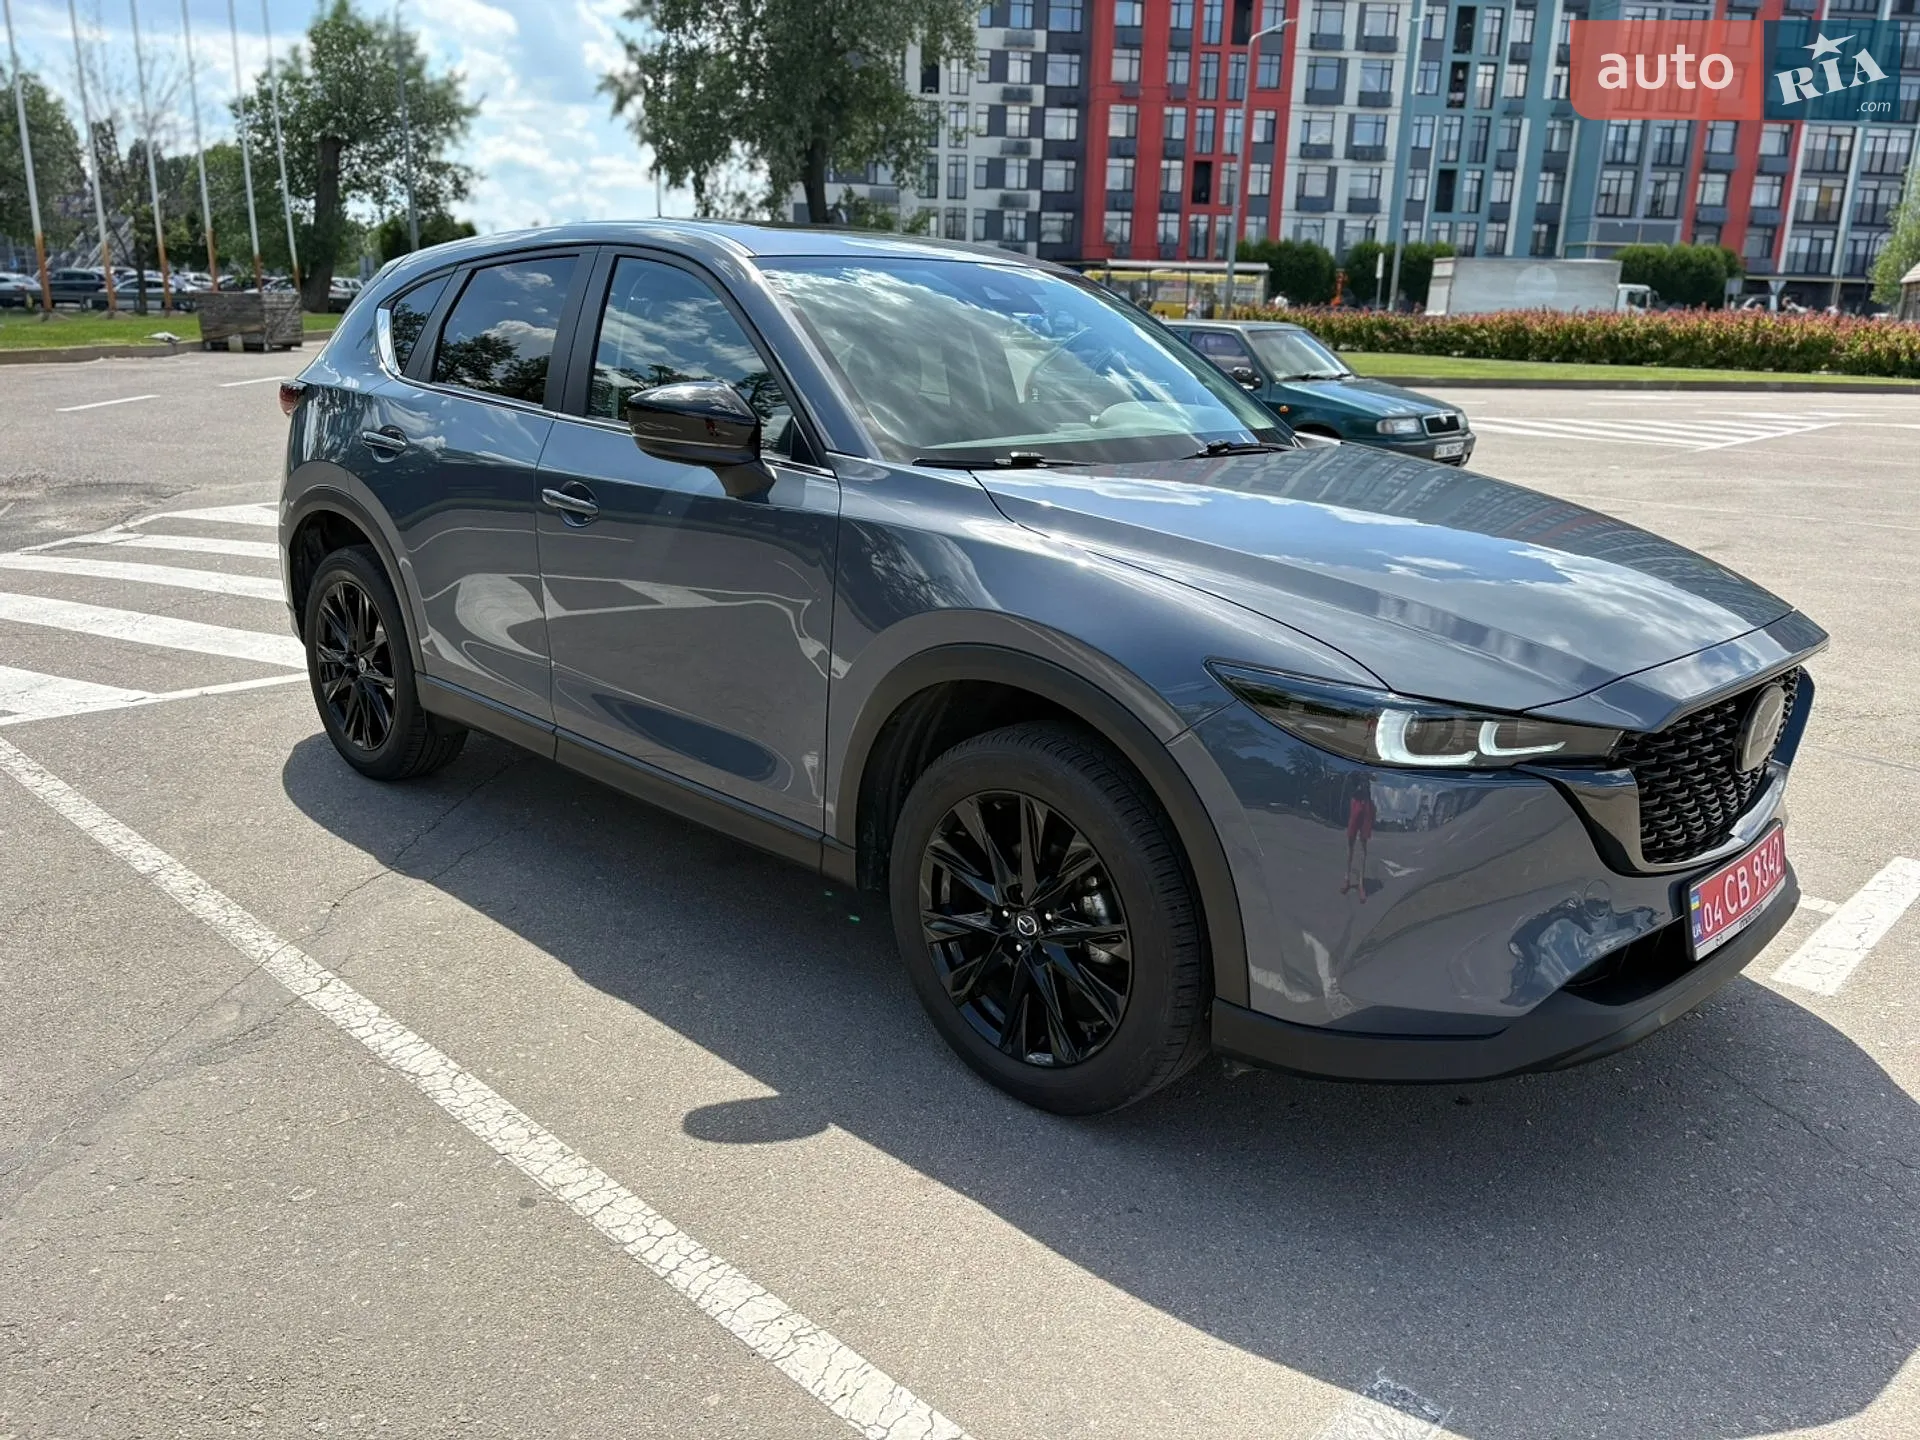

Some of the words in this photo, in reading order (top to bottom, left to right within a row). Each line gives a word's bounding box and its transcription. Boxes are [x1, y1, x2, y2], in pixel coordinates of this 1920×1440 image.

[1703, 895, 1723, 932] 04
[1724, 866, 1750, 914] CB
[1753, 836, 1781, 895] 9342
